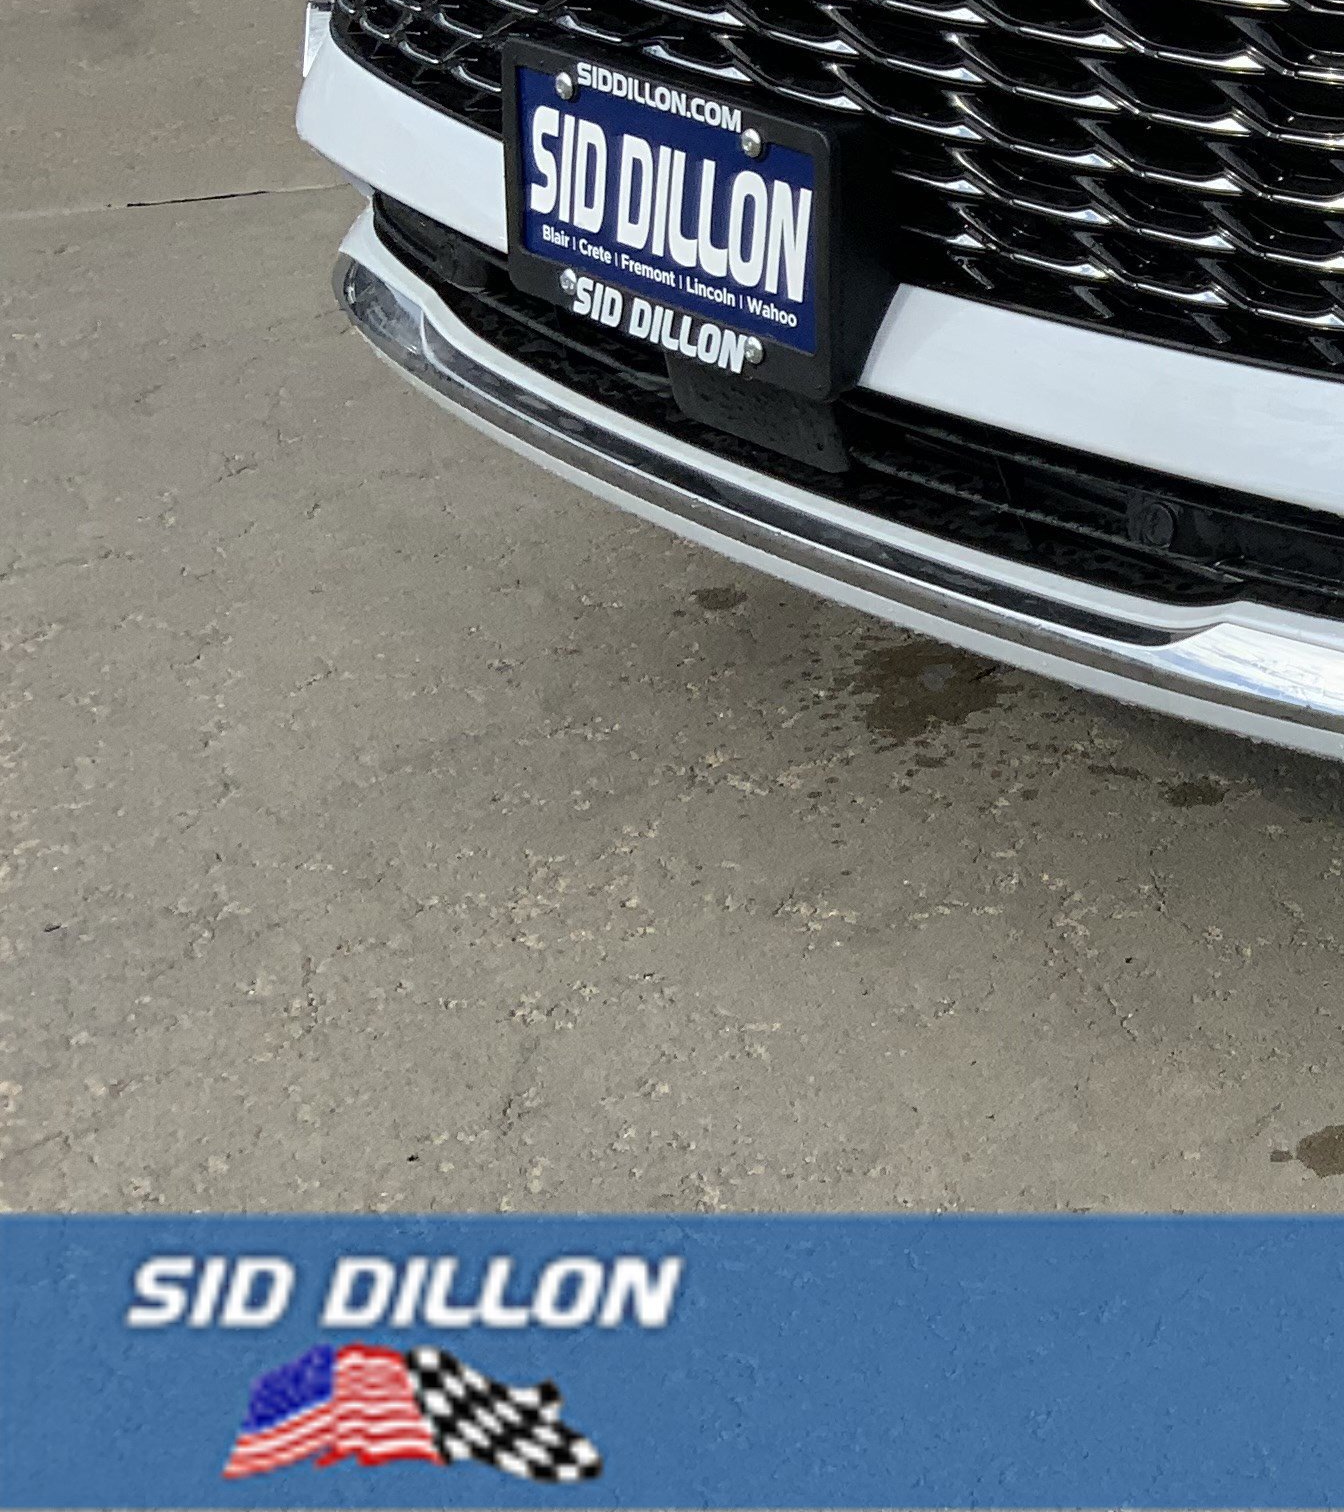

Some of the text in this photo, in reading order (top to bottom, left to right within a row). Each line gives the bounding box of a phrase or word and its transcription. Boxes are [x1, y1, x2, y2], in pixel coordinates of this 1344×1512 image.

[576, 62, 743, 134] SIDDILLON.COM
[529, 104, 814, 303] SID DILLON
[541, 224, 798, 328] Blair Crete Fremont Lincoln Wahoo
[572, 276, 747, 374] SID DILLON
